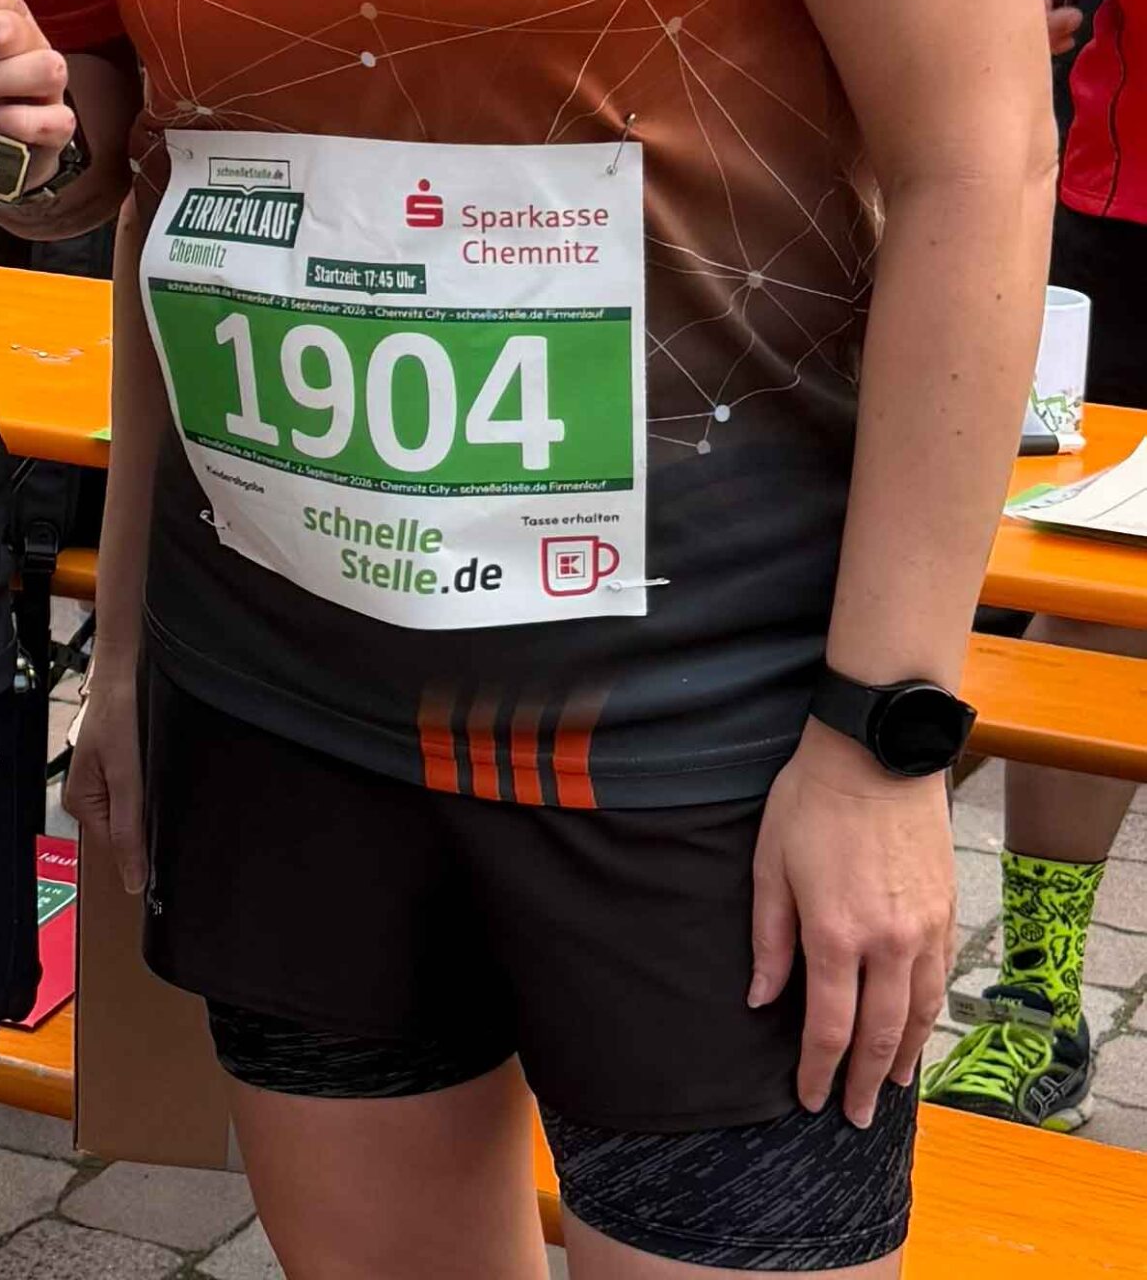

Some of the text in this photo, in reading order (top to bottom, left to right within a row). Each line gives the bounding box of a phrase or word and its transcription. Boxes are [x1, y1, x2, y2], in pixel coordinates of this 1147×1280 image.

[179, 194, 298, 241] FIRMENLAUF
[461, 203, 610, 234] Sparkasse
[169, 238, 227, 269] Chemnitz
[461, 239, 600, 266] Chemnitz
[364, 269, 394, 289] 17:45
[396, 269, 418, 289] Uhr
[214, 313, 566, 473] 1904
[548, 481, 608, 492] Firmenlauf
[303, 505, 444, 555] schnelle
[522, 512, 620, 527] Tasse erhalten
[342, 547, 503, 596] Stelle.de
